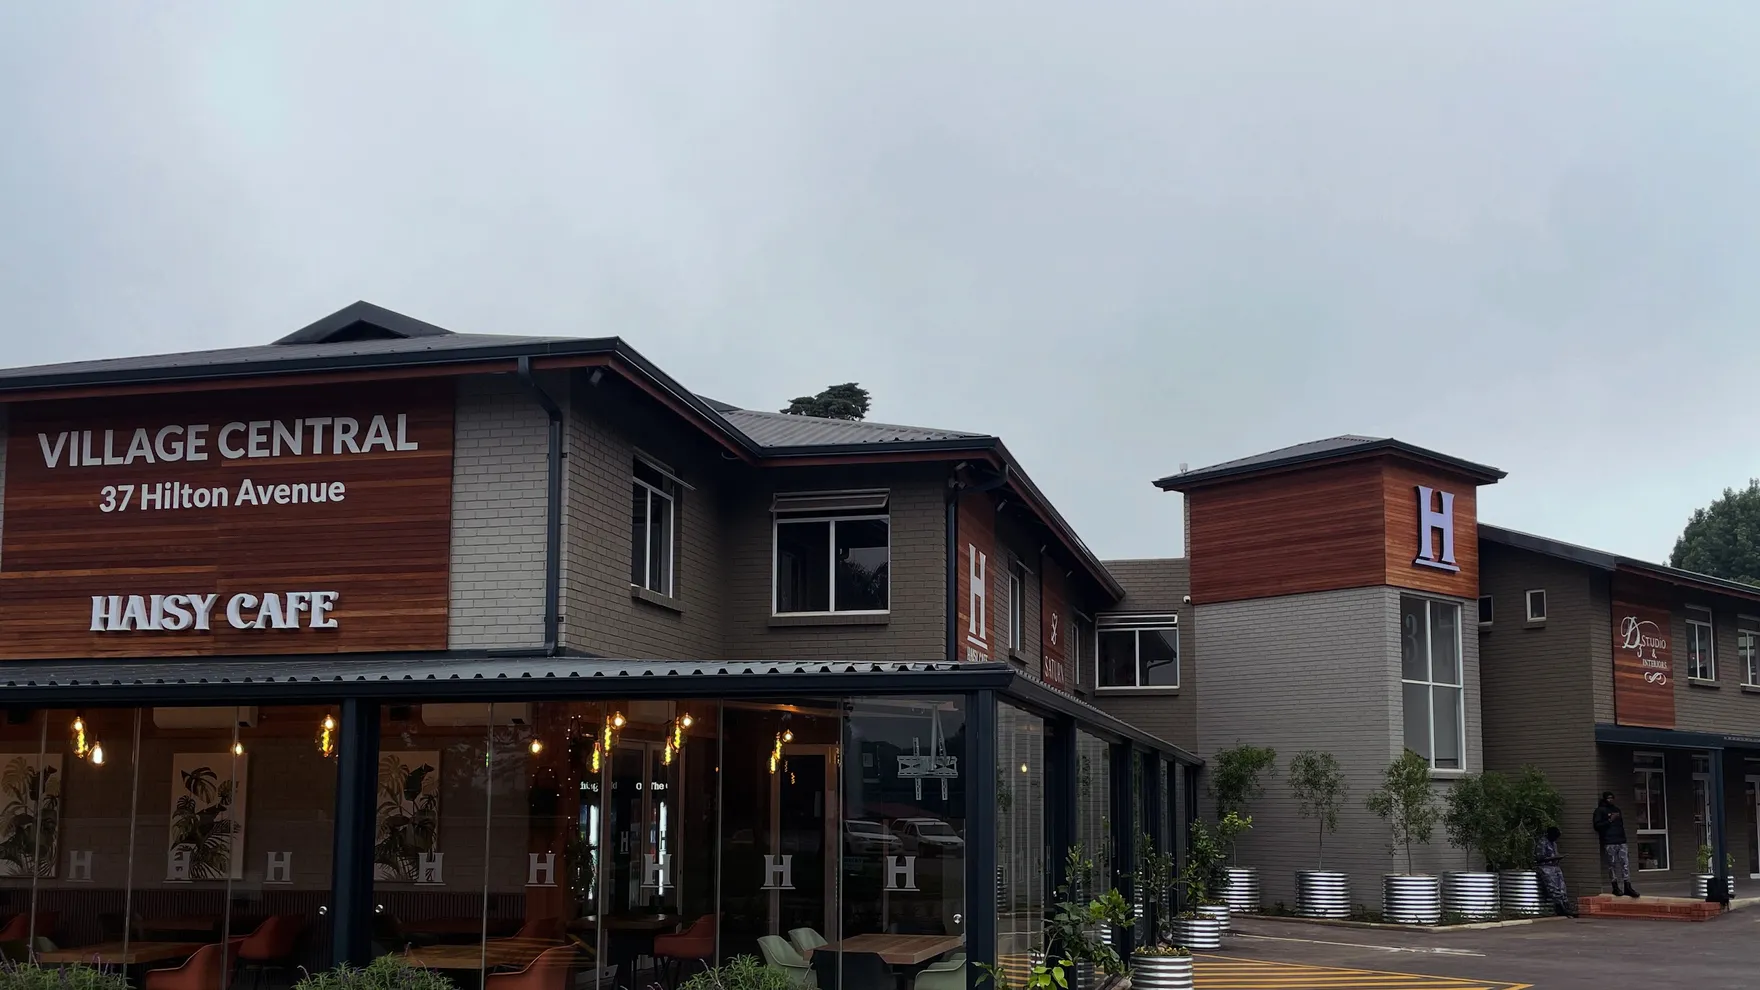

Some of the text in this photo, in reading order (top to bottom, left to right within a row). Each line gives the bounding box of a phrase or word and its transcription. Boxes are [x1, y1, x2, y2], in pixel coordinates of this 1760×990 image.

[38, 413, 419, 468] VILLAGE CENTRAL
[99, 478, 346, 513] 37 Hilton Avenue
[1418, 485, 1456, 564] H
[968, 543, 987, 640] H
[90, 591, 340, 632] HAISY CAFE
[69, 850, 93, 879] H
[266, 851, 292, 881] H
[418, 852, 444, 883] H
[529, 853, 556, 884] H
[644, 854, 672, 885] H
[764, 855, 792, 887] H
[886, 855, 916, 888] H
